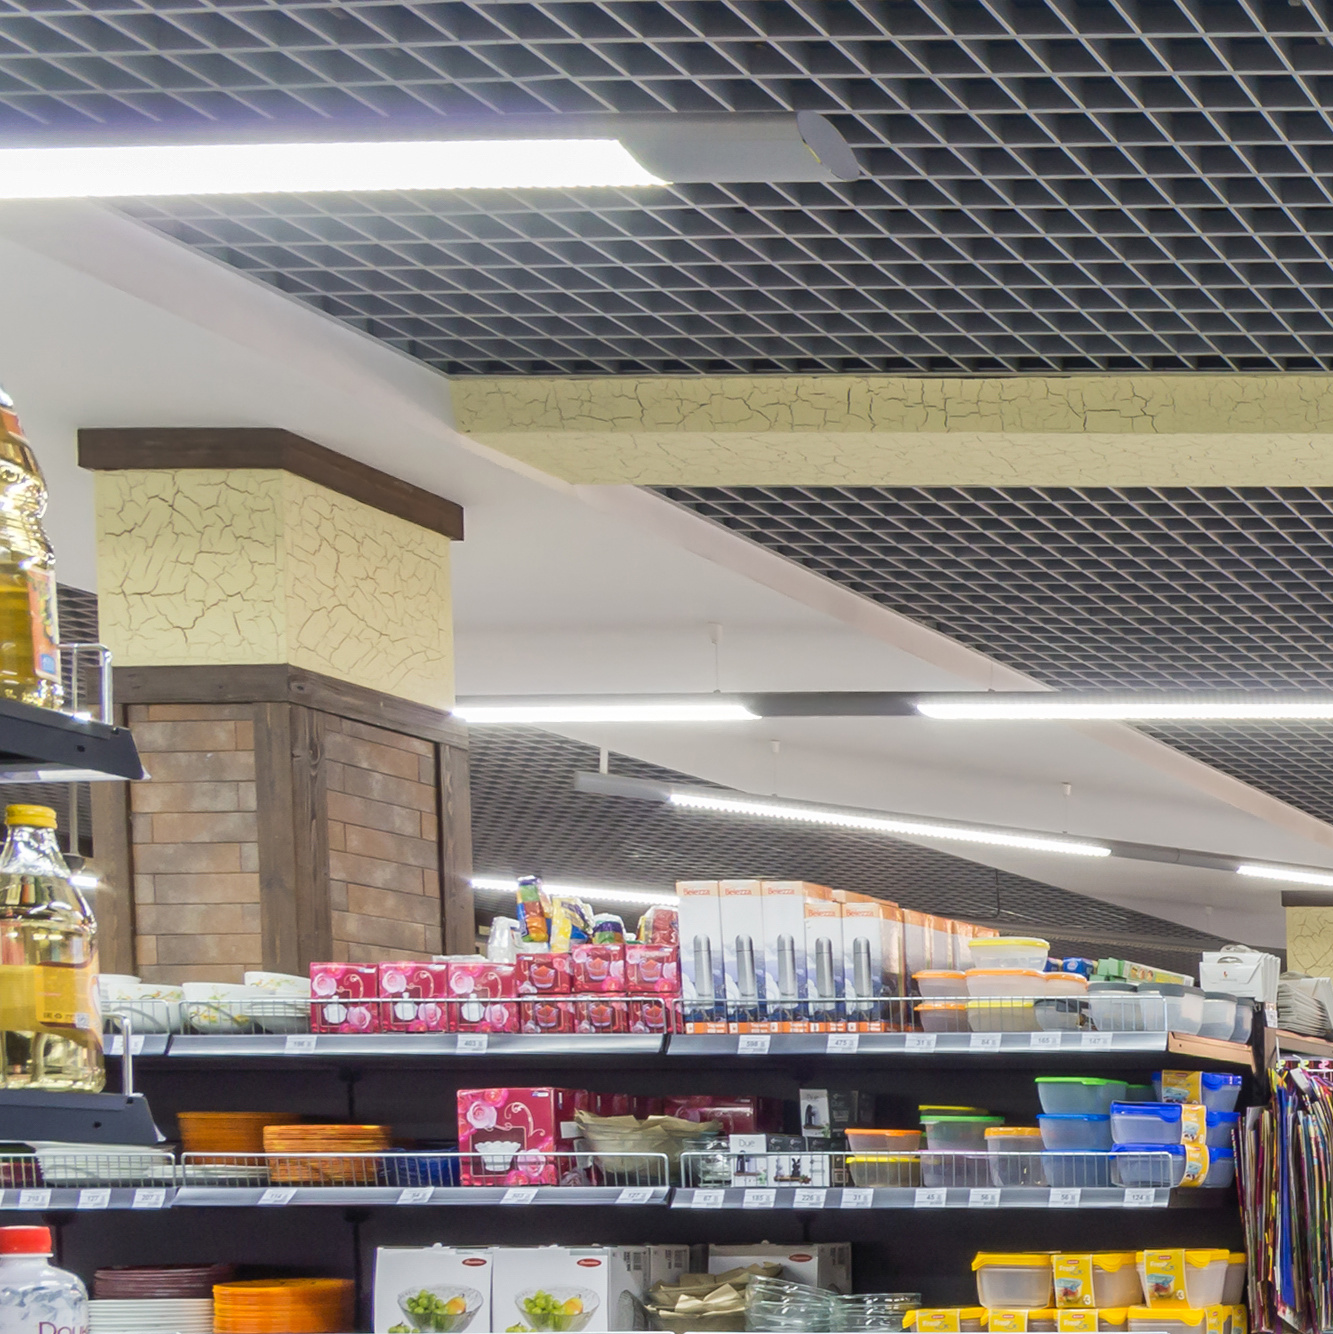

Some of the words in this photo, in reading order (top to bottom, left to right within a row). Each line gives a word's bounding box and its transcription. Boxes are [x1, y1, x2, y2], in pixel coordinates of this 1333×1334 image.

[683, 888, 711, 896] Belezza
[725, 888, 753, 896] Belezza
[768, 887, 796, 895] Belezza
[808, 909, 836, 917] Belezza
[846, 909, 874, 917] Belezza
[916, 1039, 925, 1047] 31
[738, 1139, 755, 1147] Due
